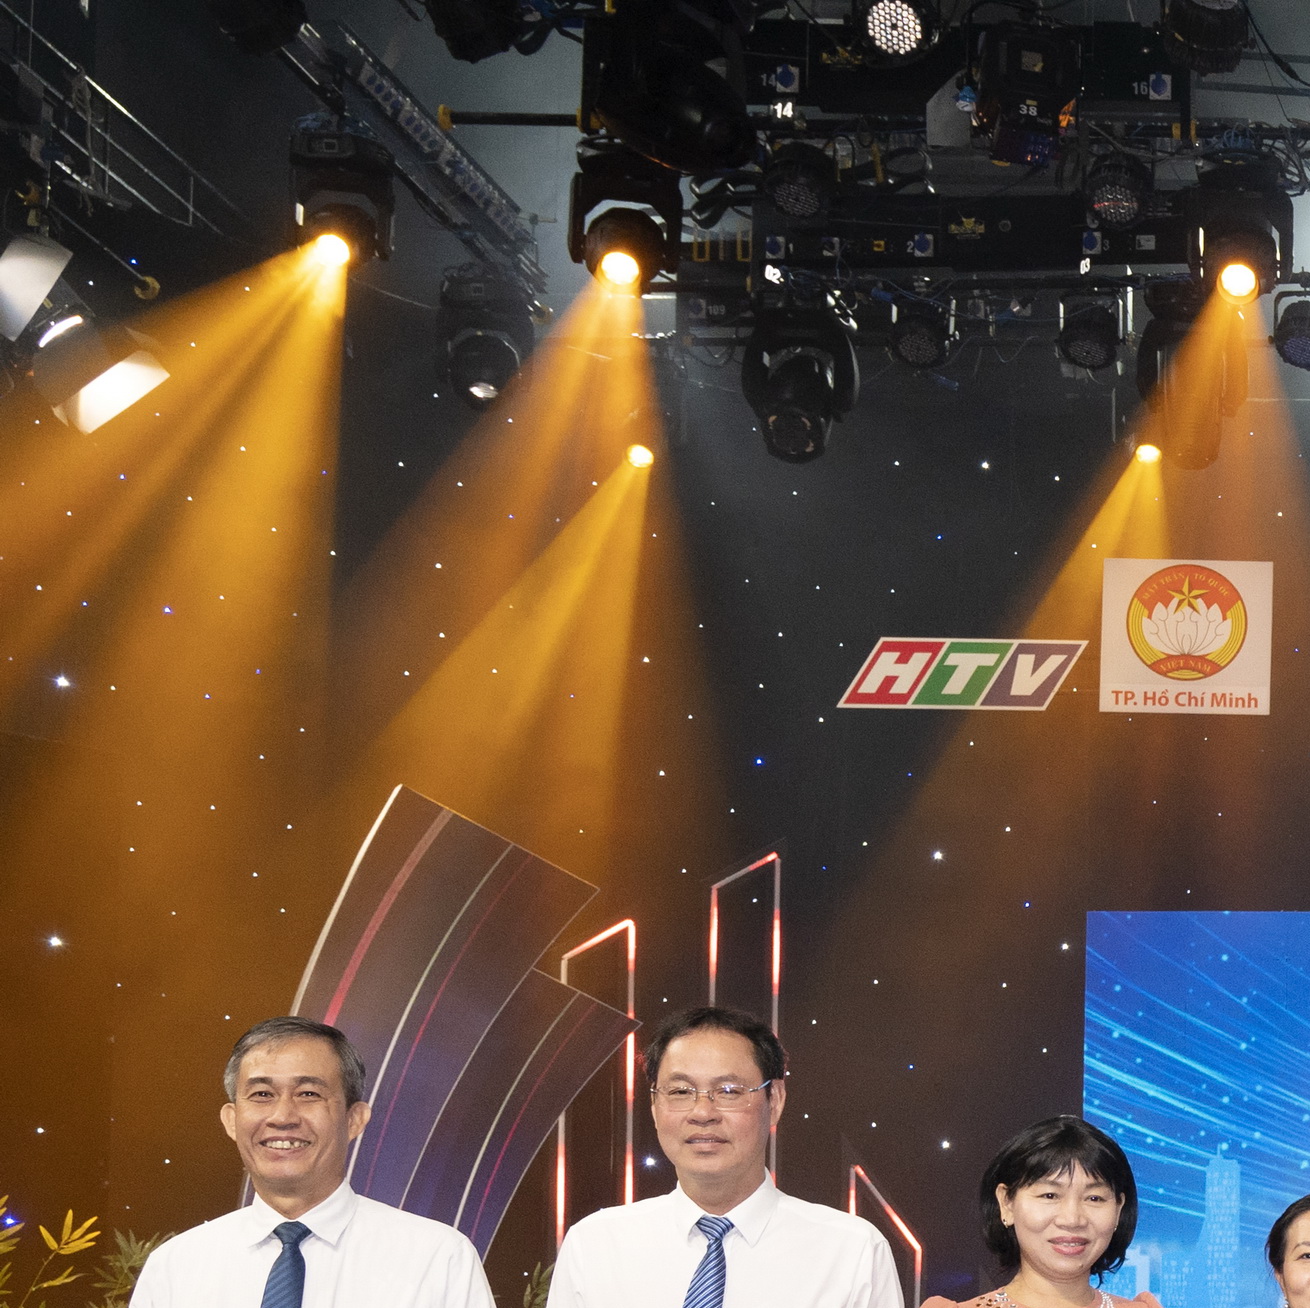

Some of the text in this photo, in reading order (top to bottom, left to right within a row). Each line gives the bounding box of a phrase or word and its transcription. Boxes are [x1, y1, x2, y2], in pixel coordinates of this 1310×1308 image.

[1132, 81, 1148, 95] 16
[774, 101, 793, 119] 14
[1019, 104, 1038, 117] 38
[857, 651, 1068, 696] HTV
[1111, 689, 1259, 708] TP. Hồ Chí Minh
